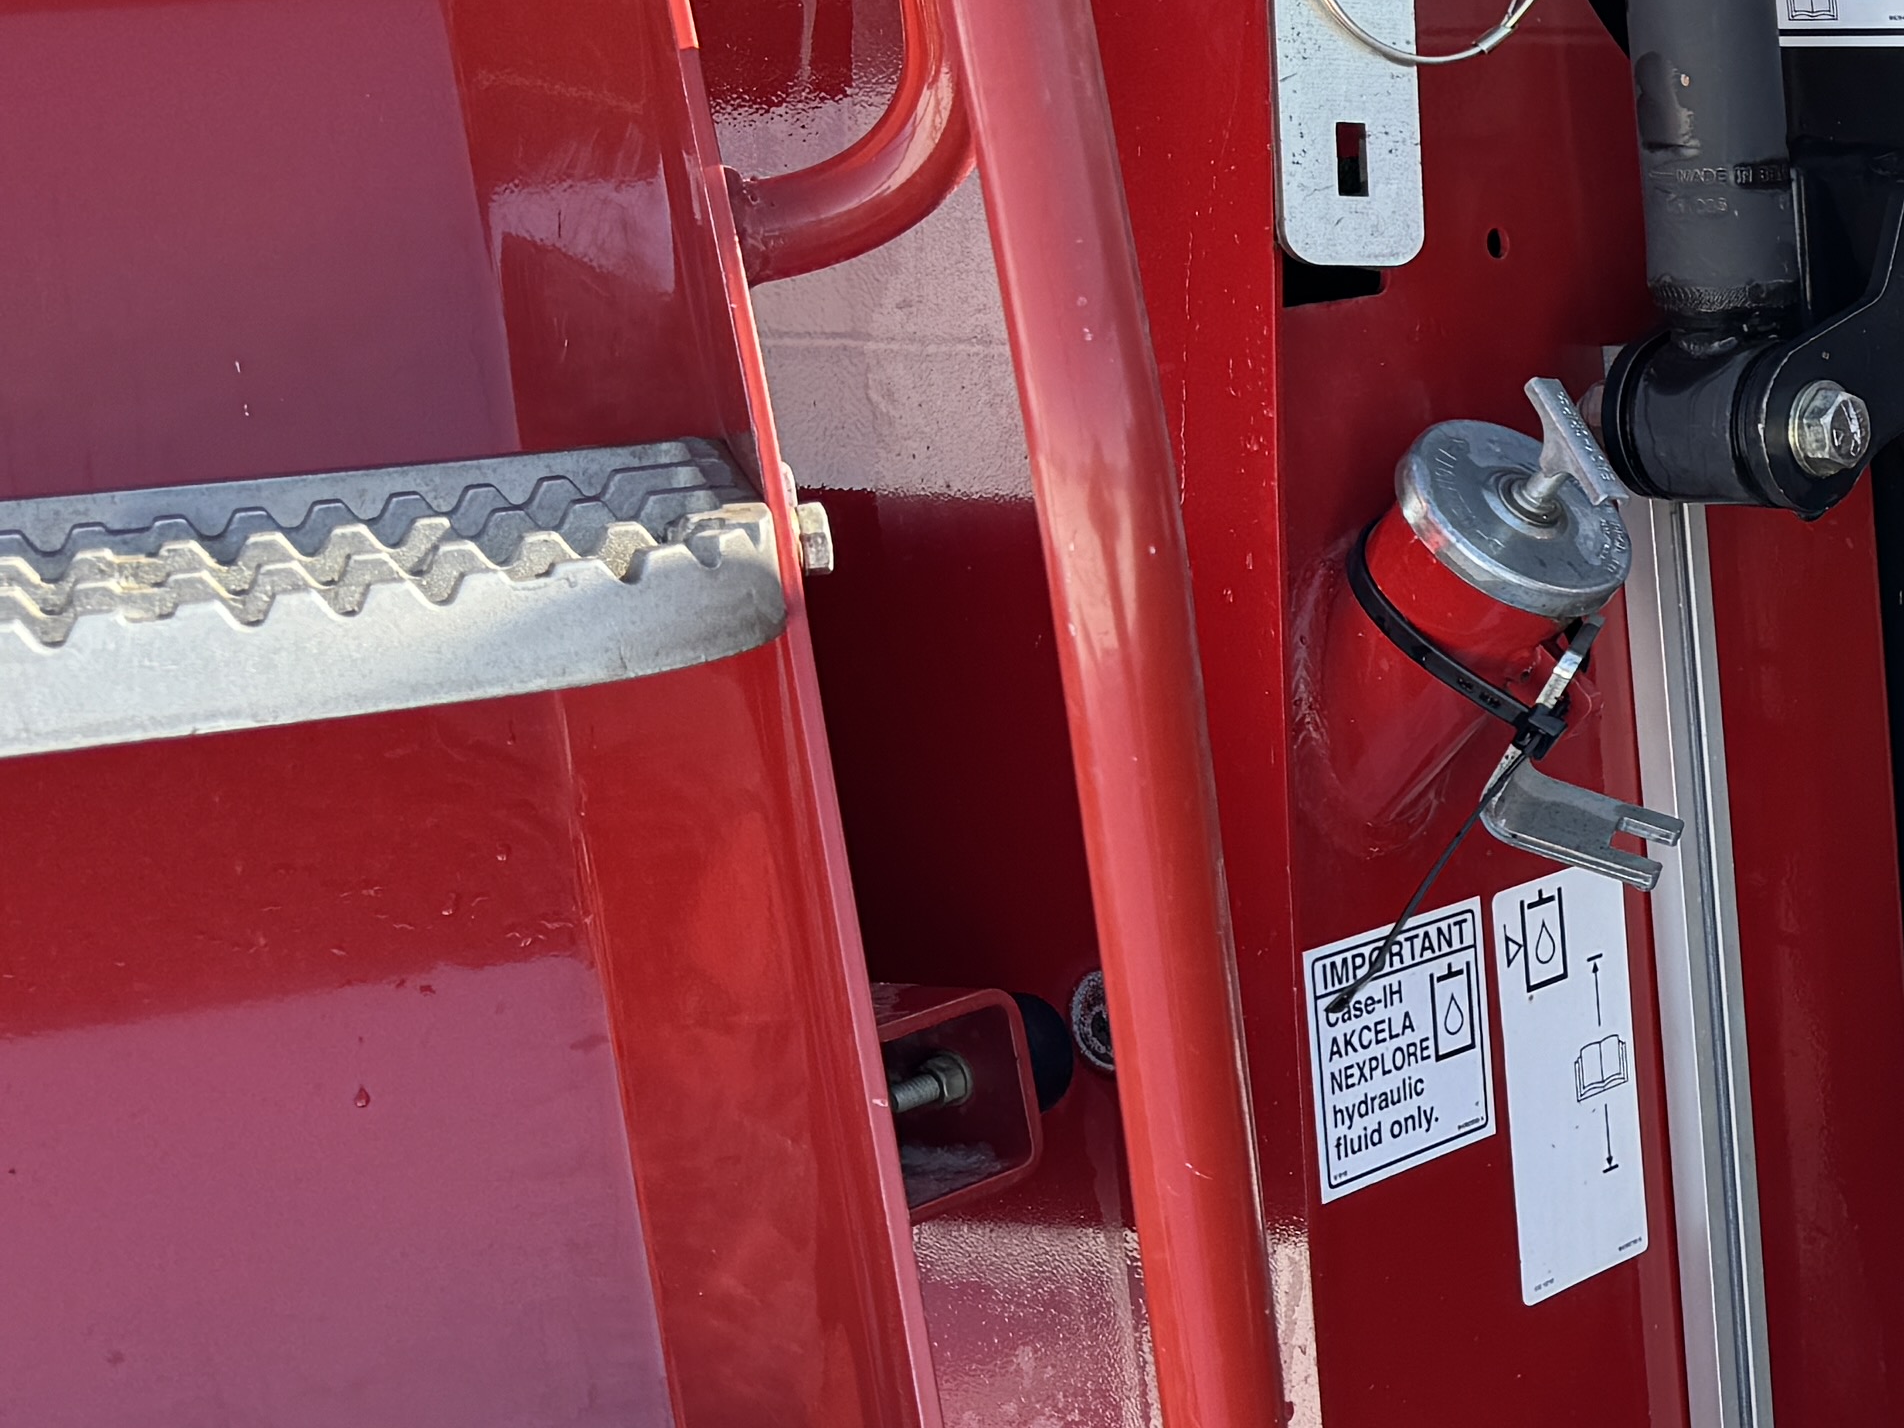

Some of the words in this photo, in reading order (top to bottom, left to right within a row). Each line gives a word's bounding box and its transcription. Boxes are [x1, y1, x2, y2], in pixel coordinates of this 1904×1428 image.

[1322, 918, 1468, 989] IMPORTANT
[1329, 1011, 1415, 1062] AKCELA
[1331, 1037, 1431, 1095] NEXPLORE
[1333, 1077, 1425, 1129] hydraulic
[1335, 1122, 1383, 1161] fluid
[1390, 1106, 1440, 1145] only.
